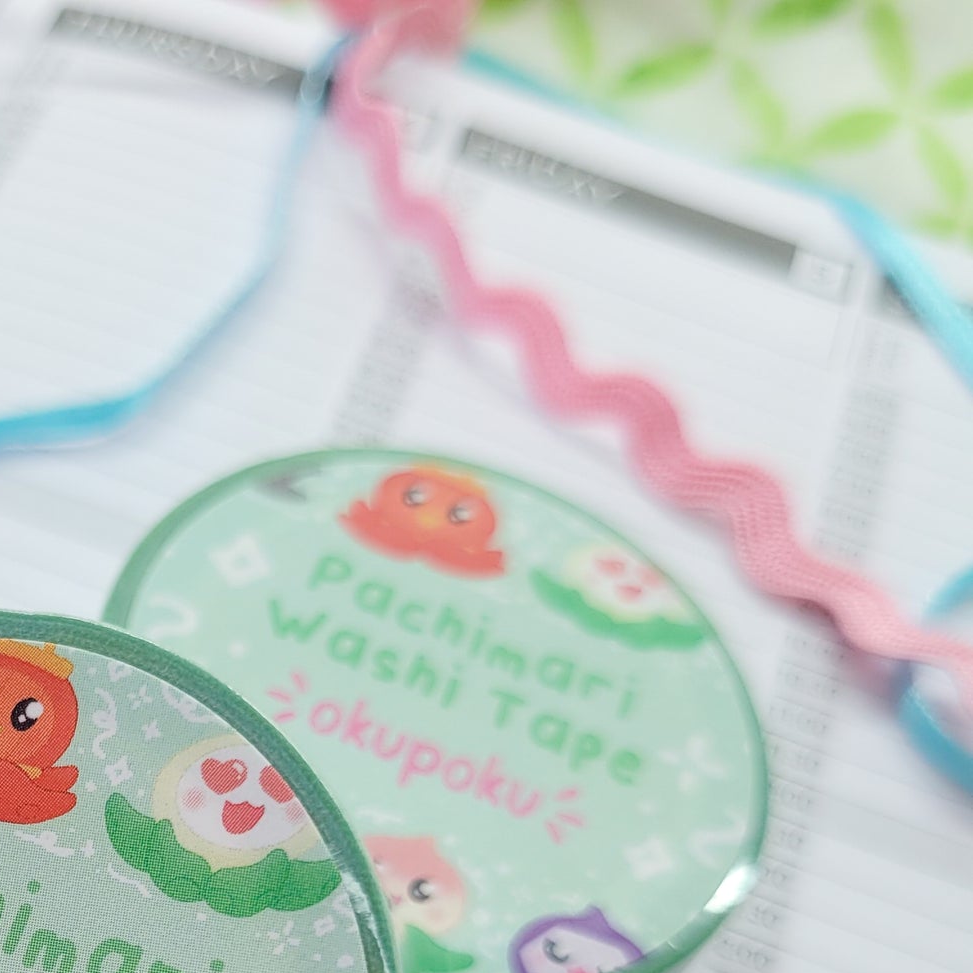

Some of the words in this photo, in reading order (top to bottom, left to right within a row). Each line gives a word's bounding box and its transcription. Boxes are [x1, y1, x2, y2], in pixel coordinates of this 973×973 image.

[268, 597, 461, 708] Washi
[489, 688, 643, 786] Tape
[308, 554, 643, 718] Pachimari
[308, 699, 542, 820] okupoku
